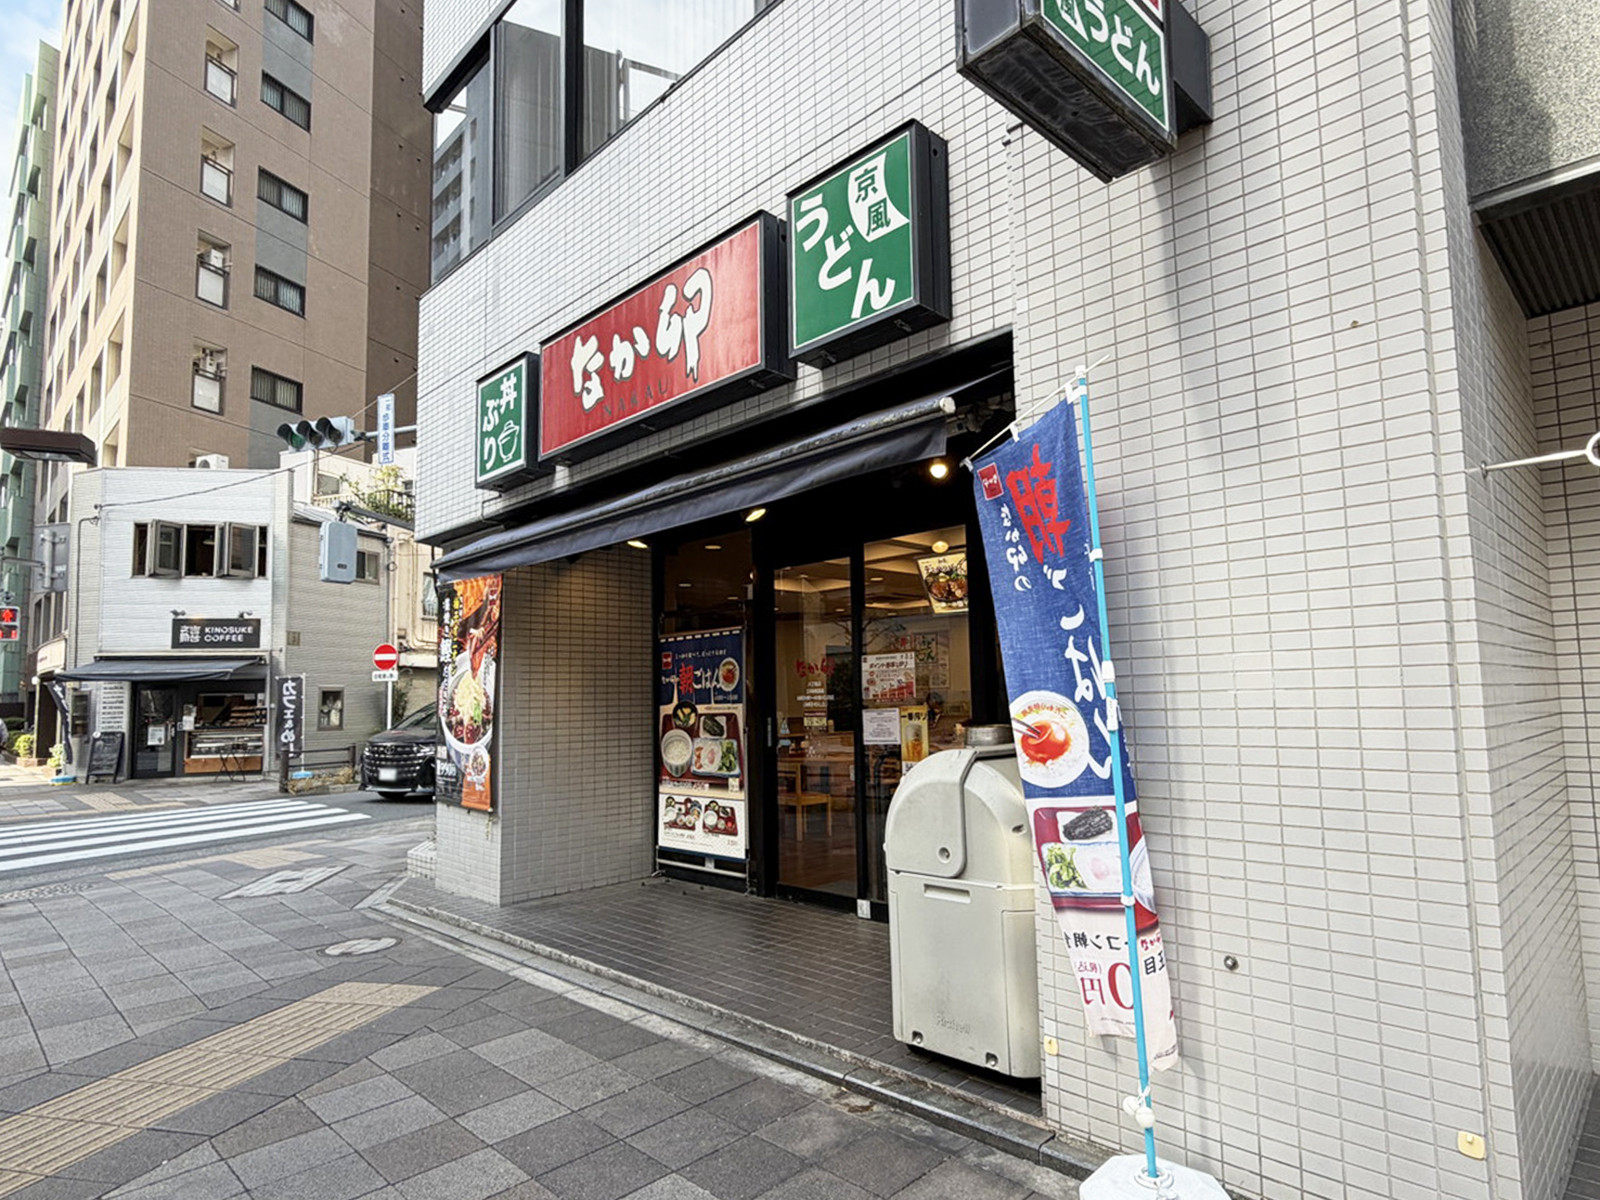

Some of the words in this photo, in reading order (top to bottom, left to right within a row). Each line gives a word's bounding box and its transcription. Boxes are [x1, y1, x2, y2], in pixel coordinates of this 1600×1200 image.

[1085, 0, 1160, 96] うどん
[855, 165, 891, 236] 京風
[796, 193, 896, 319] うどん
[571, 267, 713, 412] なか卯
[483, 372, 518, 471] 丼ぶり
[604, 377, 669, 415] NAKAU
[204, 626, 254, 635] KINOSUKE
[204, 634, 244, 642] COFFEE
